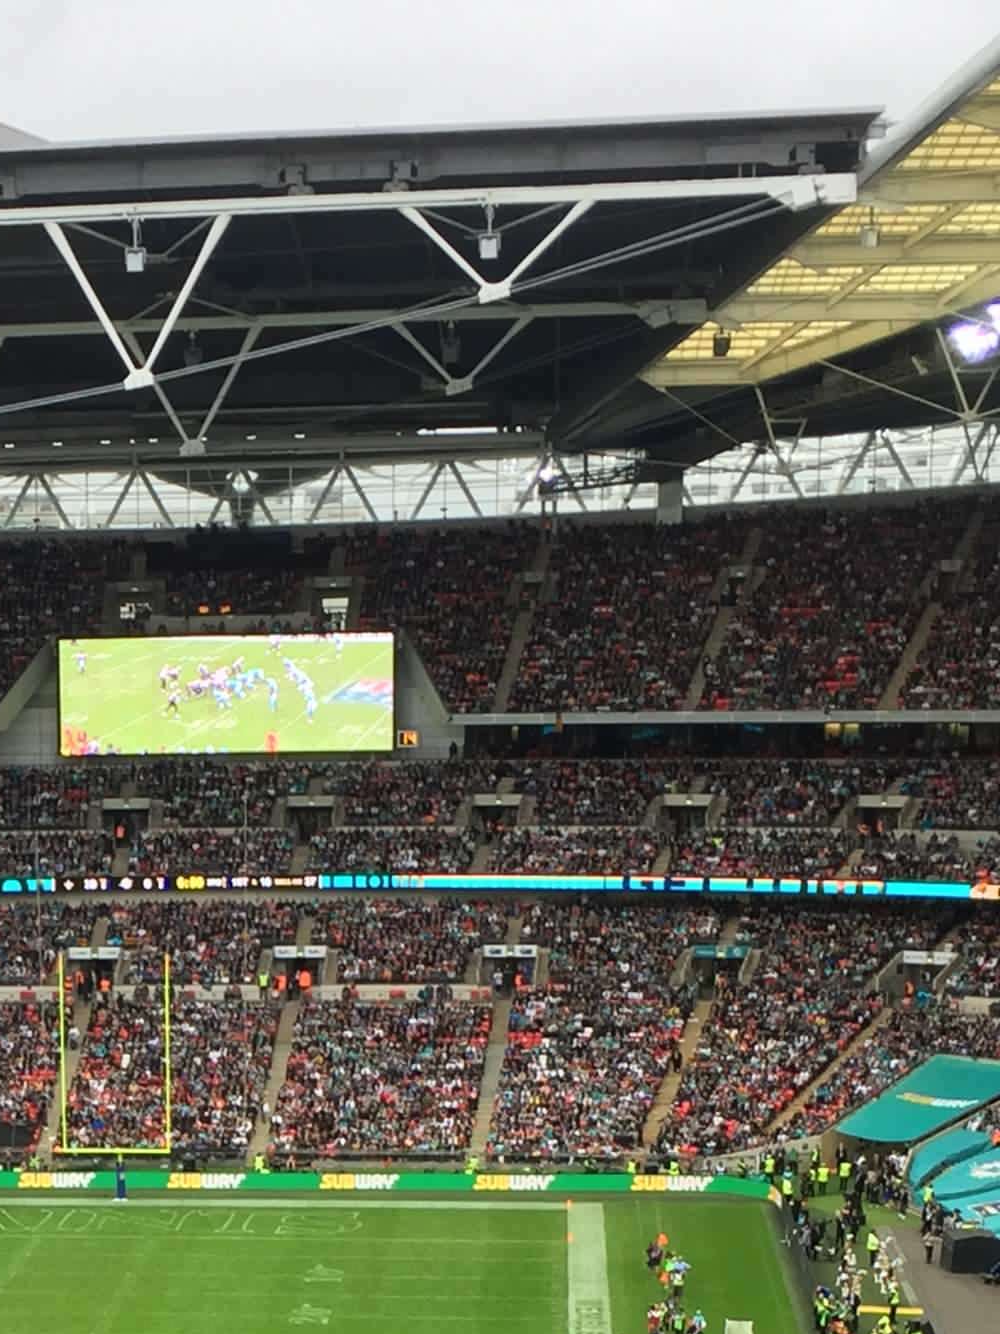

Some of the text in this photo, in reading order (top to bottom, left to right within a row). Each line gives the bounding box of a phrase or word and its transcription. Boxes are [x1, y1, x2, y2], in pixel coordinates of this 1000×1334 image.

[17, 1171, 96, 1188] SUBWAY
[166, 1172, 246, 1189] SUBWAY
[319, 1172, 400, 1190] SUBWAY
[472, 1173, 555, 1191] SUBWAY
[631, 1174, 713, 1191] SUBWAY
